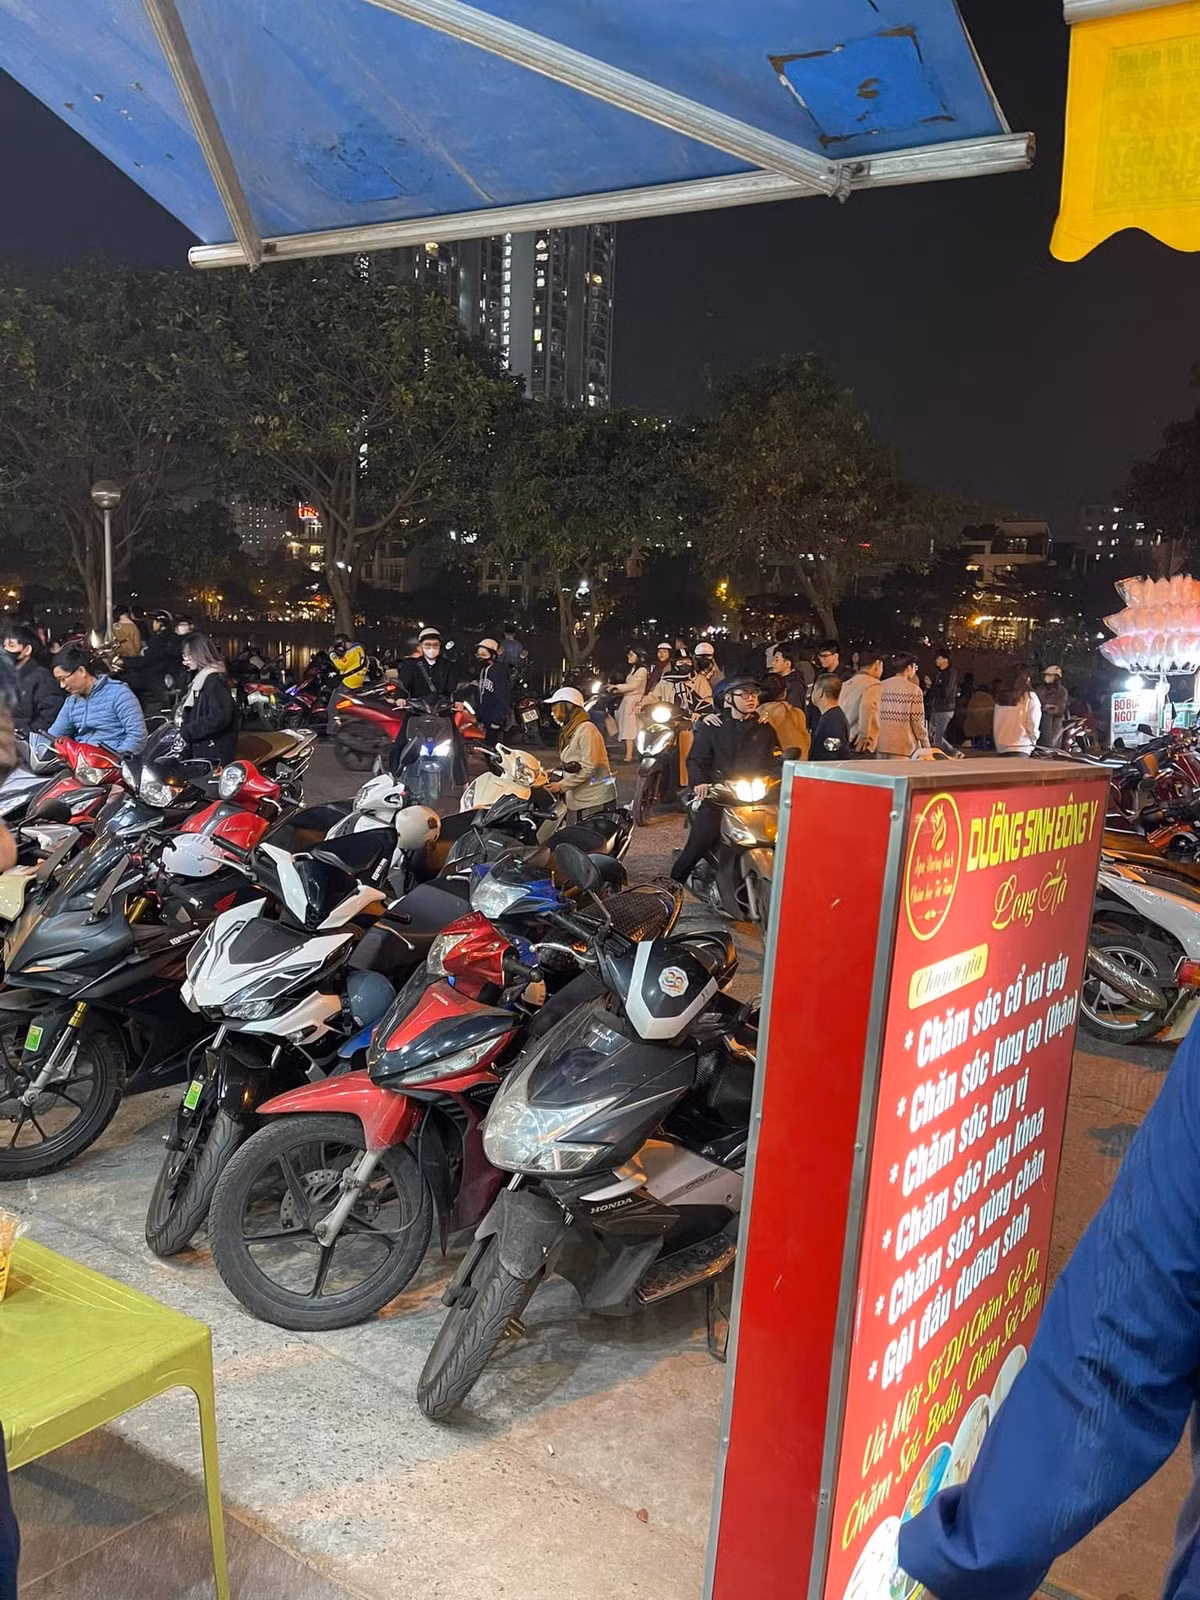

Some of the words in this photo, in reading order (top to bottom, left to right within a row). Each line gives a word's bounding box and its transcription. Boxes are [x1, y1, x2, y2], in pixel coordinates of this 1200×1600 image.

[966, 801, 1024, 872] DƯỠNG
[1022, 807, 1056, 857] SINH
[1053, 792, 1089, 850] ĐÔNG
[1088, 799, 1099, 841] Y
[992, 874, 1038, 930] Long
[1037, 858, 1067, 916] Hà
[909, 1067, 957, 1134] Chăn
[959, 1048, 990, 1099] sóc
[991, 1029, 1025, 1077] lưng
[1025, 1018, 1043, 1053] eo
[1044, 989, 1078, 1044] (thận)
[916, 1007, 970, 1068] Chăm
[972, 987, 1002, 1037] sóc
[1003, 963, 1026, 1018] cổ
[1025, 962, 1046, 1006] vai
[1046, 952, 1069, 998] gáy
[895, 1186, 950, 1261] Chăm
[952, 1159, 982, 1212] sóc
[983, 1134, 1012, 1188] phụ
[1012, 1107, 1045, 1157] khoa
[902, 1127, 956, 1197] Chăm
[958, 1102, 988, 1153] sóc
[1015, 1067, 1030, 1112] vị
[590, 1197, 633, 1214] HONDA
[888, 1245, 943, 1326] Chăm
[945, 1215, 976, 1269] sóc
[978, 1179, 1013, 1236] vùng
[1014, 1148, 1046, 1200] chân
[861, 1418, 887, 1479] Và
[888, 1382, 923, 1449] Một
[923, 1345, 947, 1404] Số
[943, 1321, 970, 1380] DV
[969, 1293, 1003, 1348] Chăm
[1003, 1263, 1023, 1306] Sóc
[1023, 1247, 1040, 1283] Da
[881, 1318, 916, 1390] Gội
[918, 1283, 952, 1351] đầu
[954, 1237, 1000, 1310] dưỡng
[1001, 1203, 1031, 1258] sinh
[841, 1470, 893, 1551] Chăm
[895, 1427, 923, 1484] Sóc
[924, 1379, 963, 1447] Body,
[967, 1335, 1001, 1391] Chăm
[1001, 1304, 1020, 1347] Sóc
